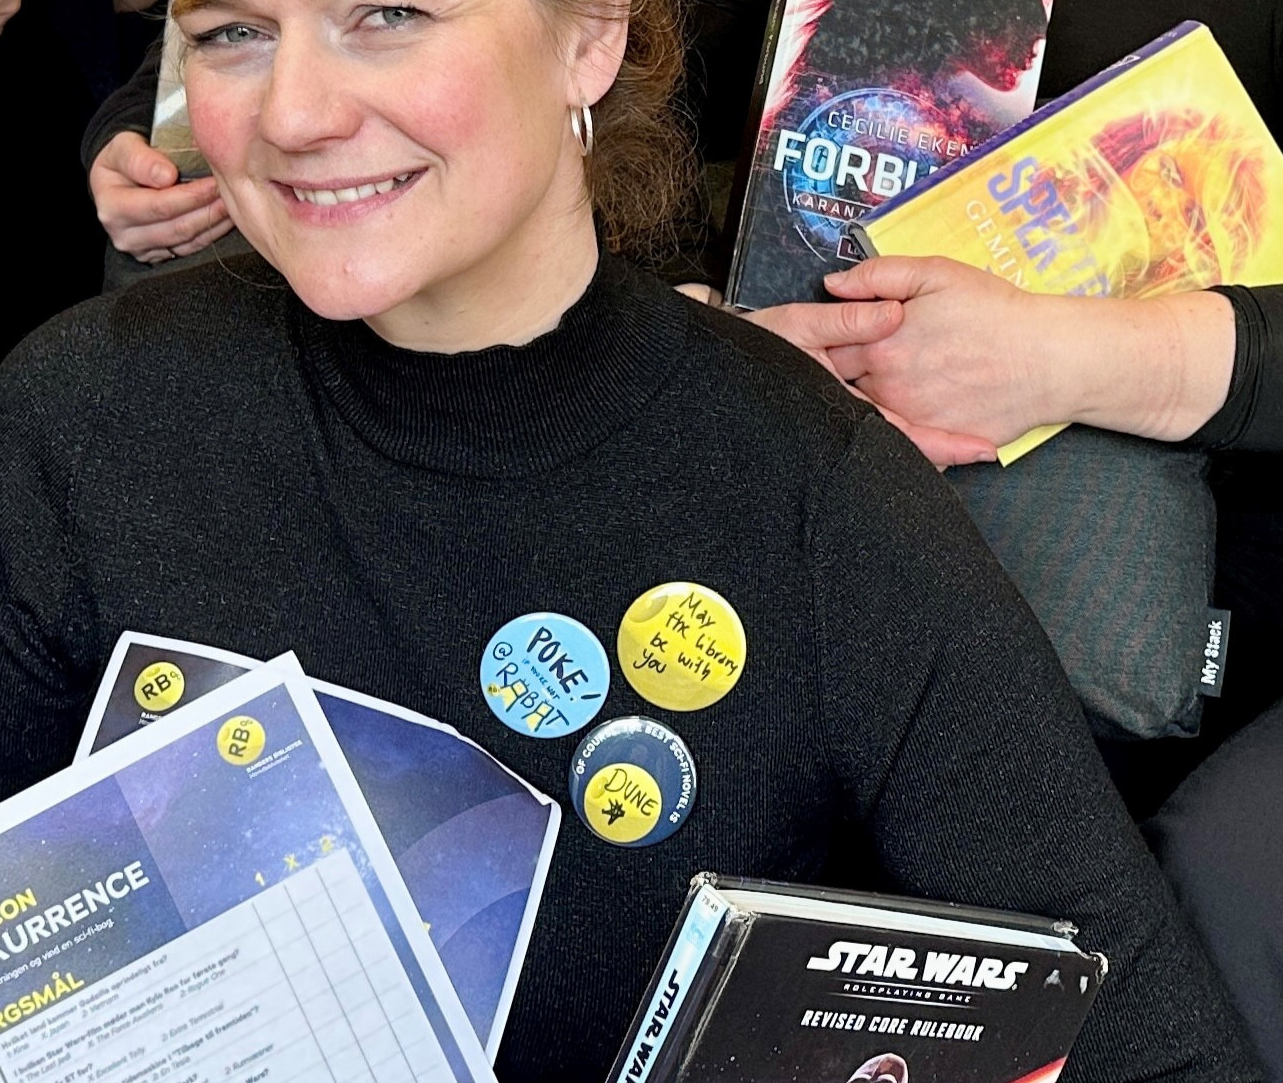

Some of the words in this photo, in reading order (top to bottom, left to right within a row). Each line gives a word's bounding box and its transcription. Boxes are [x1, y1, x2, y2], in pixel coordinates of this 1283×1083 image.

[828, 111, 909, 145] CECILIE
[966, 199, 1031, 288] GEMIN
[679, 591, 716, 629] May
[650, 631, 668, 653] be
[678, 652, 711, 681] with
[666, 611, 690, 640] the
[696, 633, 738, 677] library
[1204, 620, 1222, 658] Stack
[527, 626, 602, 702] POKE!
[633, 648, 667, 674] you
[1201, 659, 1220, 685] My
[141, 674, 172, 700] RB
[229, 726, 250, 759] RB
[644, 724, 670, 744] BEST
[576, 759, 586, 775] OF
[604, 768, 659, 816] DUNE
[676, 773, 692, 810] NOVEL
[669, 811, 681, 824] IS
[255, 872, 265, 887] 1
[284, 853, 298, 870] X
[806, 941, 918, 980] STAR
[922, 951, 1029, 990] WARS
[645, 968, 680, 1039] STAR
[843, 983, 931, 999] ROLEPLAYING
[939, 993, 972, 1003] GAME
[801, 1009, 864, 1031] REVISED
[868, 1016, 909, 1035] CORE
[910, 1020, 985, 1042] RULEBOOK
[624, 1041, 655, 1083] WA
